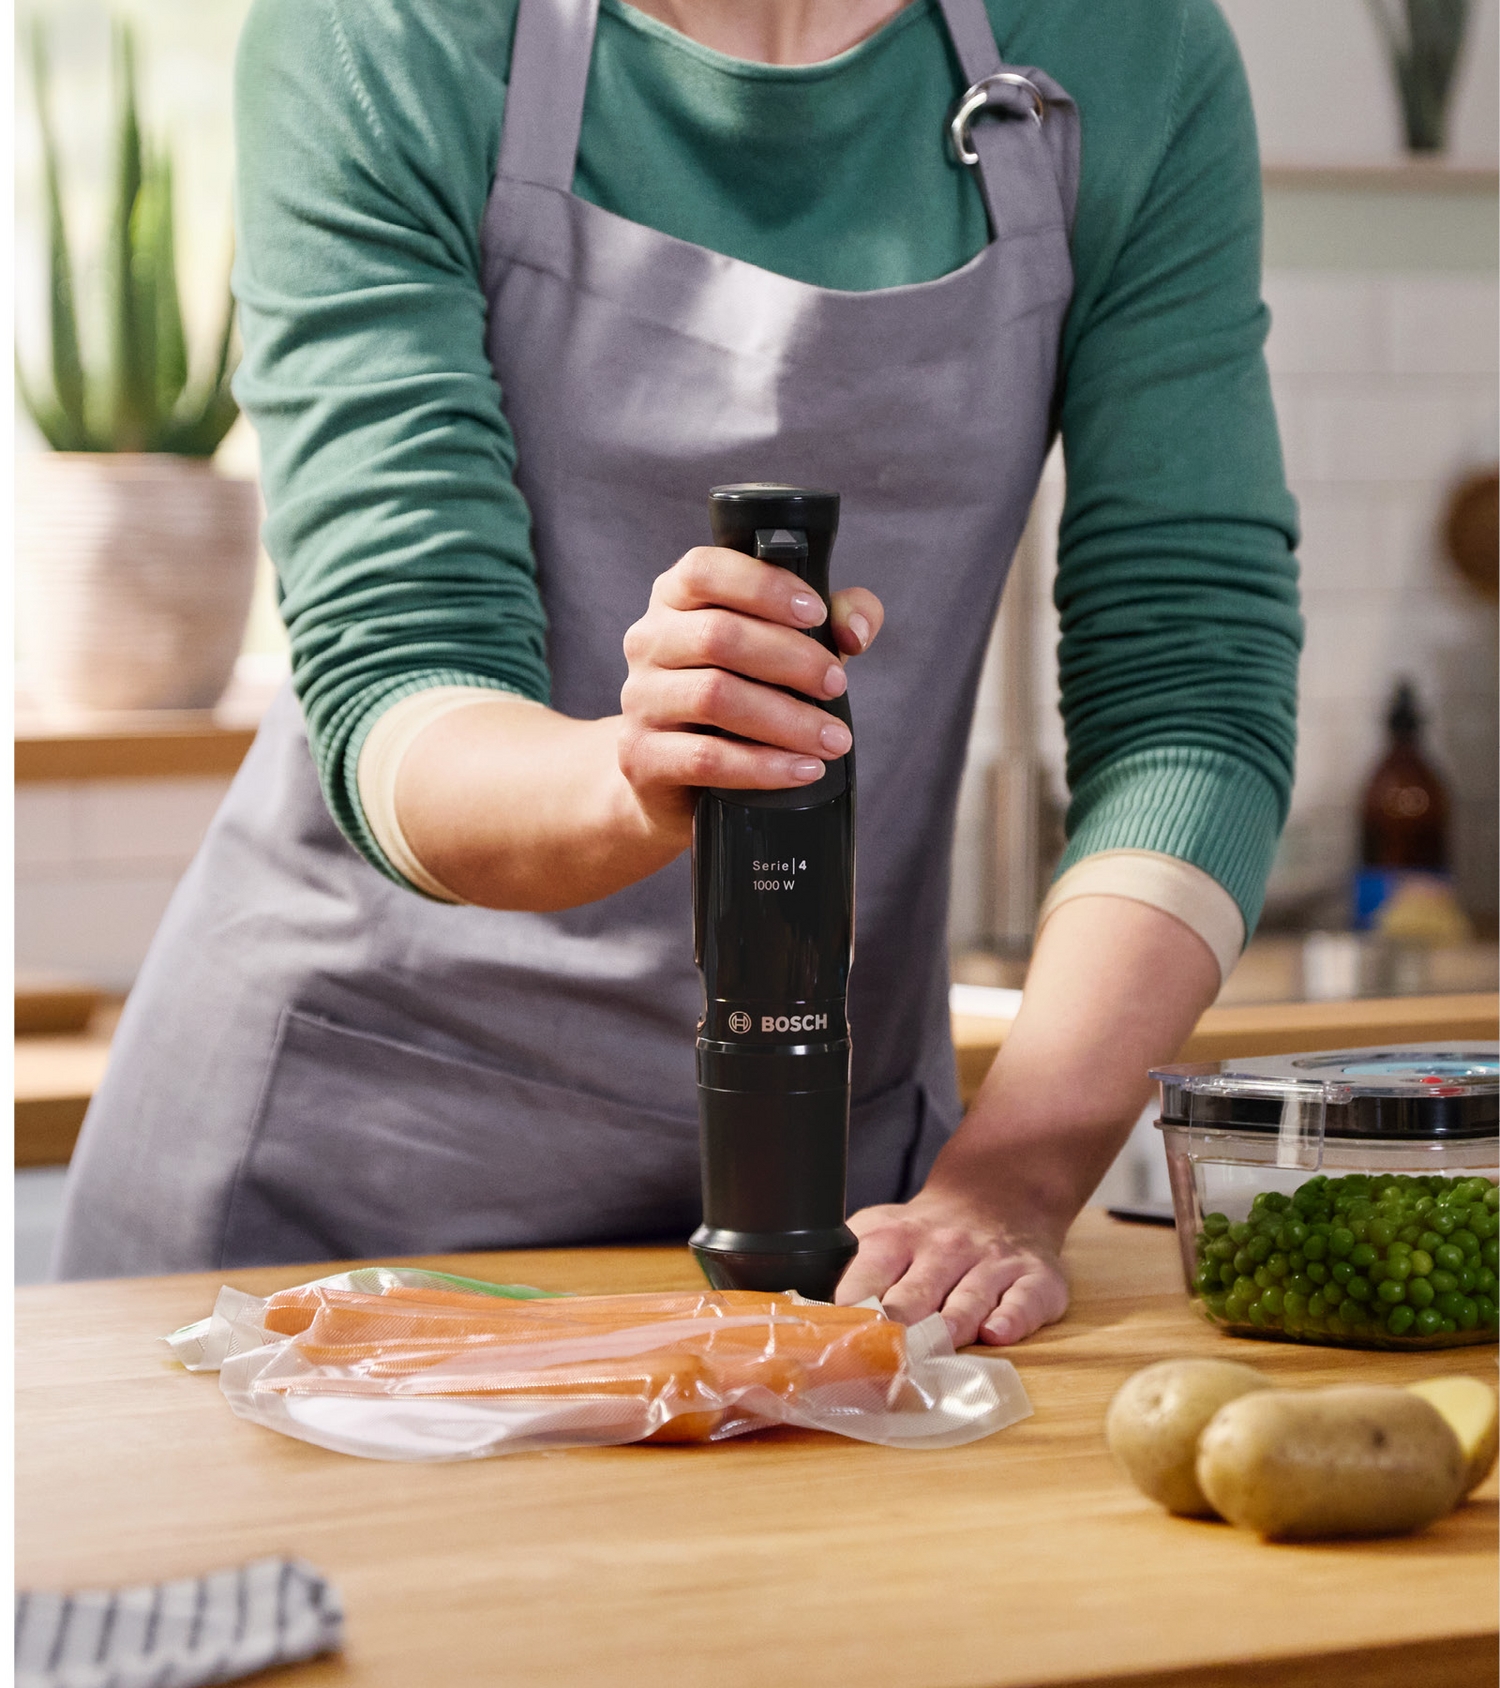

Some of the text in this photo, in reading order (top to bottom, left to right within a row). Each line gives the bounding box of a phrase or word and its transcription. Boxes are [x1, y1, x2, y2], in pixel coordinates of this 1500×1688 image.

[753, 880, 795, 891] 1000 W
[761, 1013, 828, 1032] BOSCH
